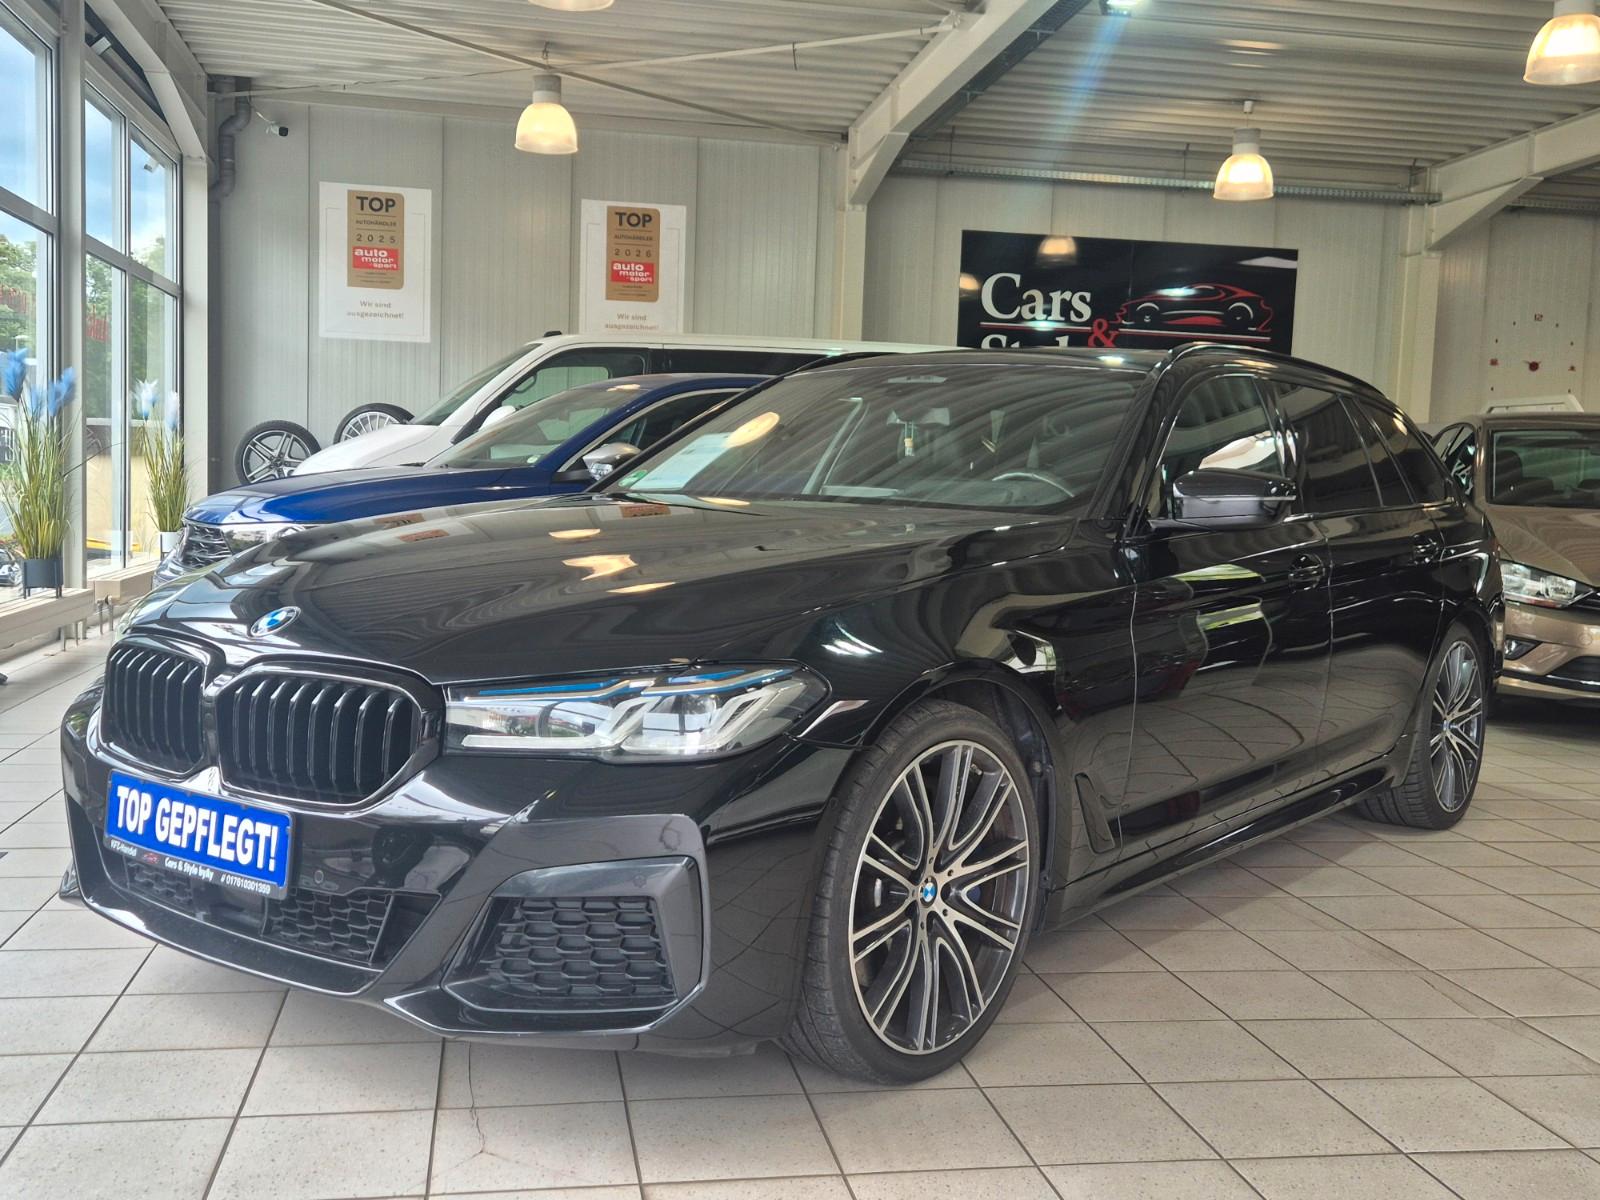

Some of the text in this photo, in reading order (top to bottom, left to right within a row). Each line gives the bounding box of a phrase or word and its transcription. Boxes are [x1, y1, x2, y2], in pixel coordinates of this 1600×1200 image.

[356, 195, 397, 213] TOP
[615, 211, 653, 228] TOP
[356, 233, 396, 244] 2025
[354, 248, 388, 257] auto
[614, 248, 652, 258] 2026
[613, 262, 645, 271] auto
[360, 300, 373, 308] Wir
[981, 272, 1092, 323] Cars
[1088, 318, 1119, 348] &
[117, 785, 279, 872] TOP GEPFLEGT!
[164, 856, 177, 870] Cars
